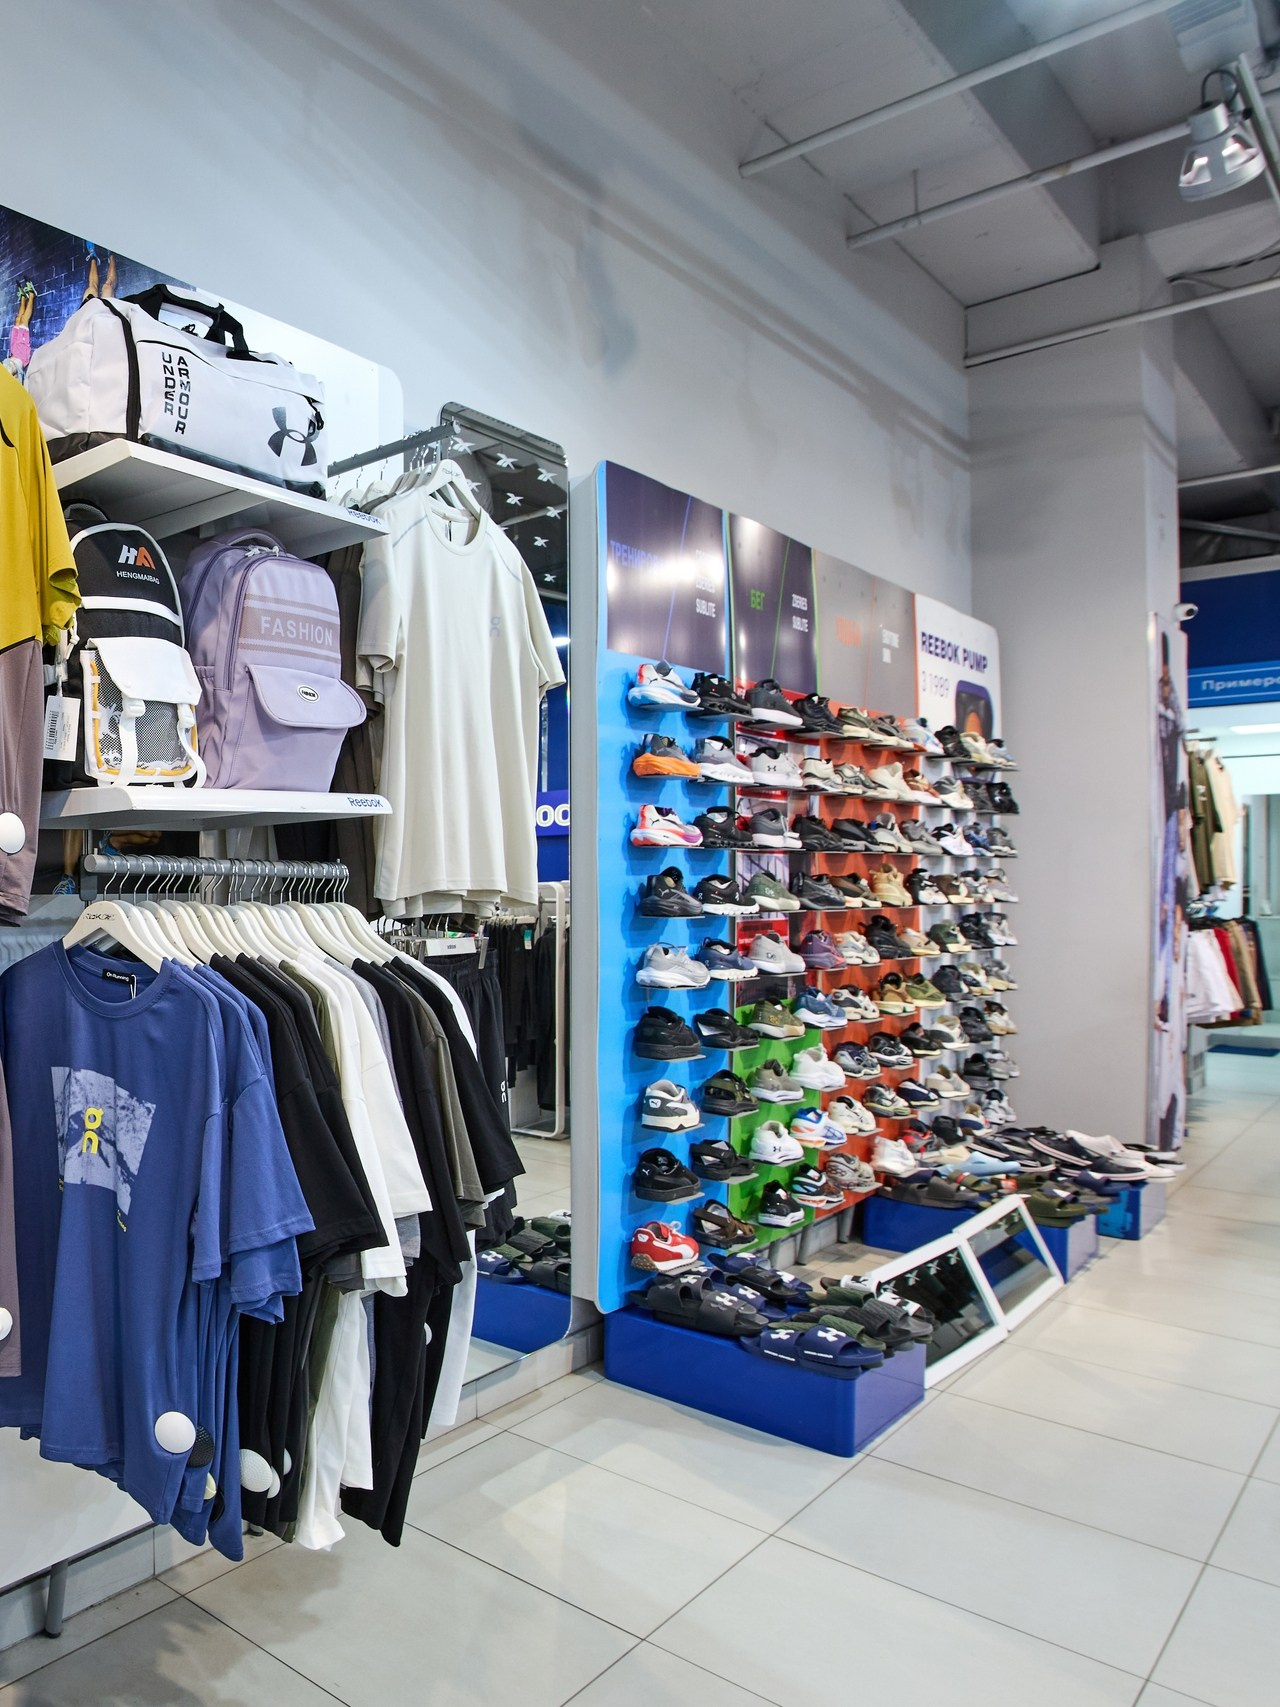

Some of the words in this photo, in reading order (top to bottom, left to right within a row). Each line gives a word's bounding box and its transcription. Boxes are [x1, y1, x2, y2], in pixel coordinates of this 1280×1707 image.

[161, 351, 176, 416] UNDER
[175, 355, 191, 435] ARMOUR
[261, 615, 334, 647] FASHION
[921, 631, 961, 665] REEBOK
[963, 647, 988, 674] PUMP
[347, 796, 384, 808] Reebok
